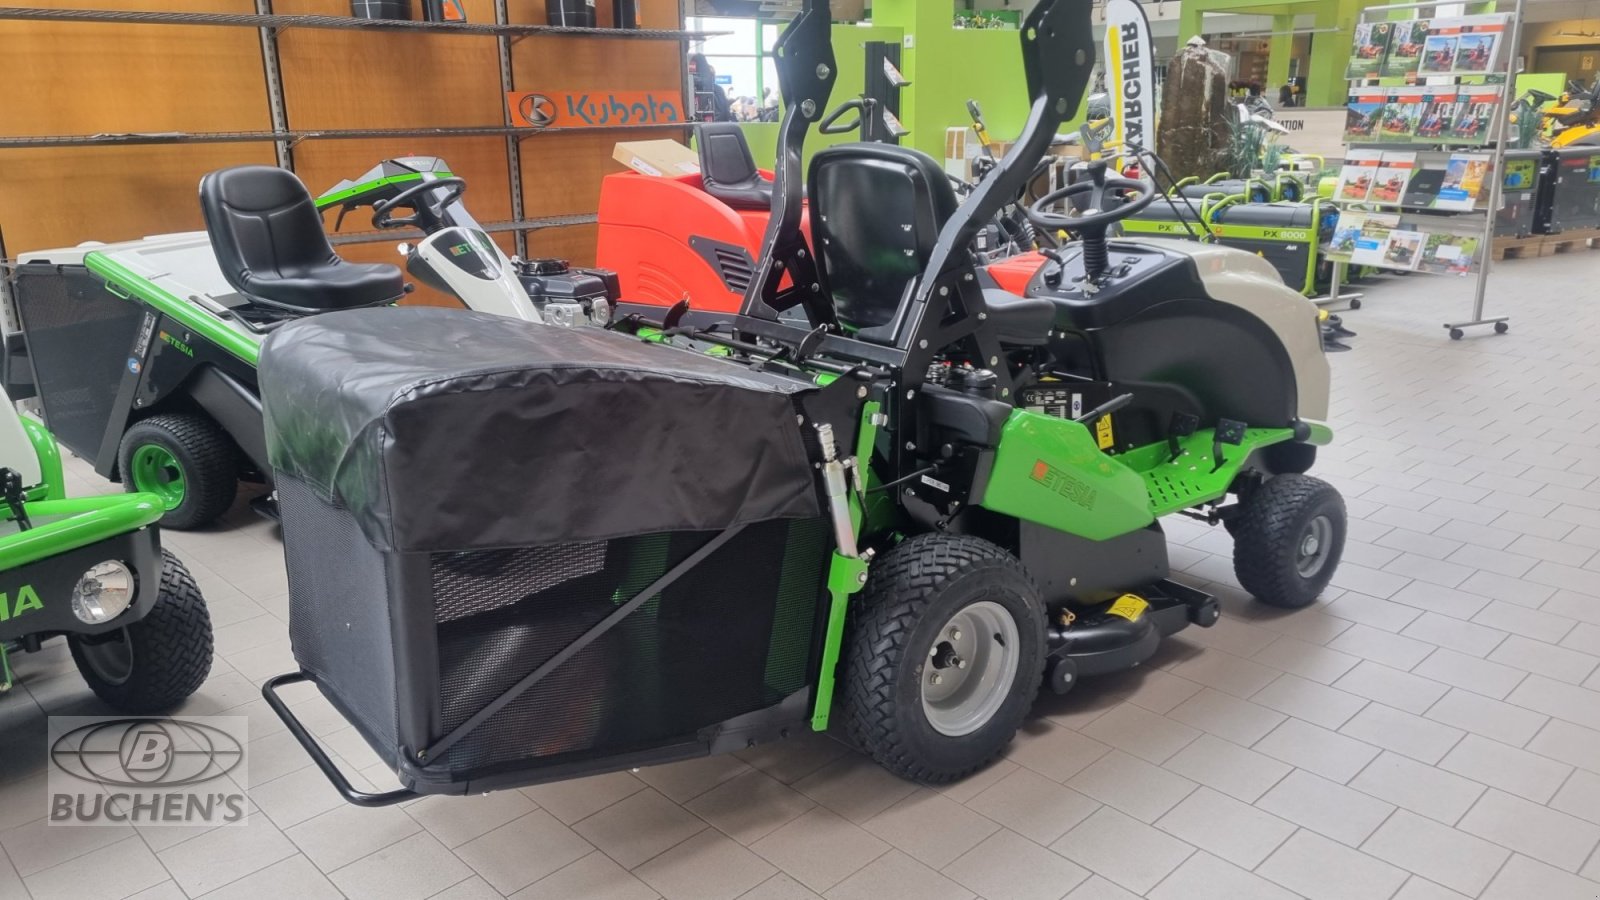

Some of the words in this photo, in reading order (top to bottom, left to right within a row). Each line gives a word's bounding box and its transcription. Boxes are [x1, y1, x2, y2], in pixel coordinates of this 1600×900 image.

[566, 95, 677, 124] Kubota
[1277, 120, 1304, 130] ATION
[1158, 224, 1171, 232] PX
[1263, 230, 1278, 238] PX
[159, 330, 194, 358] ETESIA
[1029, 458, 1097, 511] ETESIA
